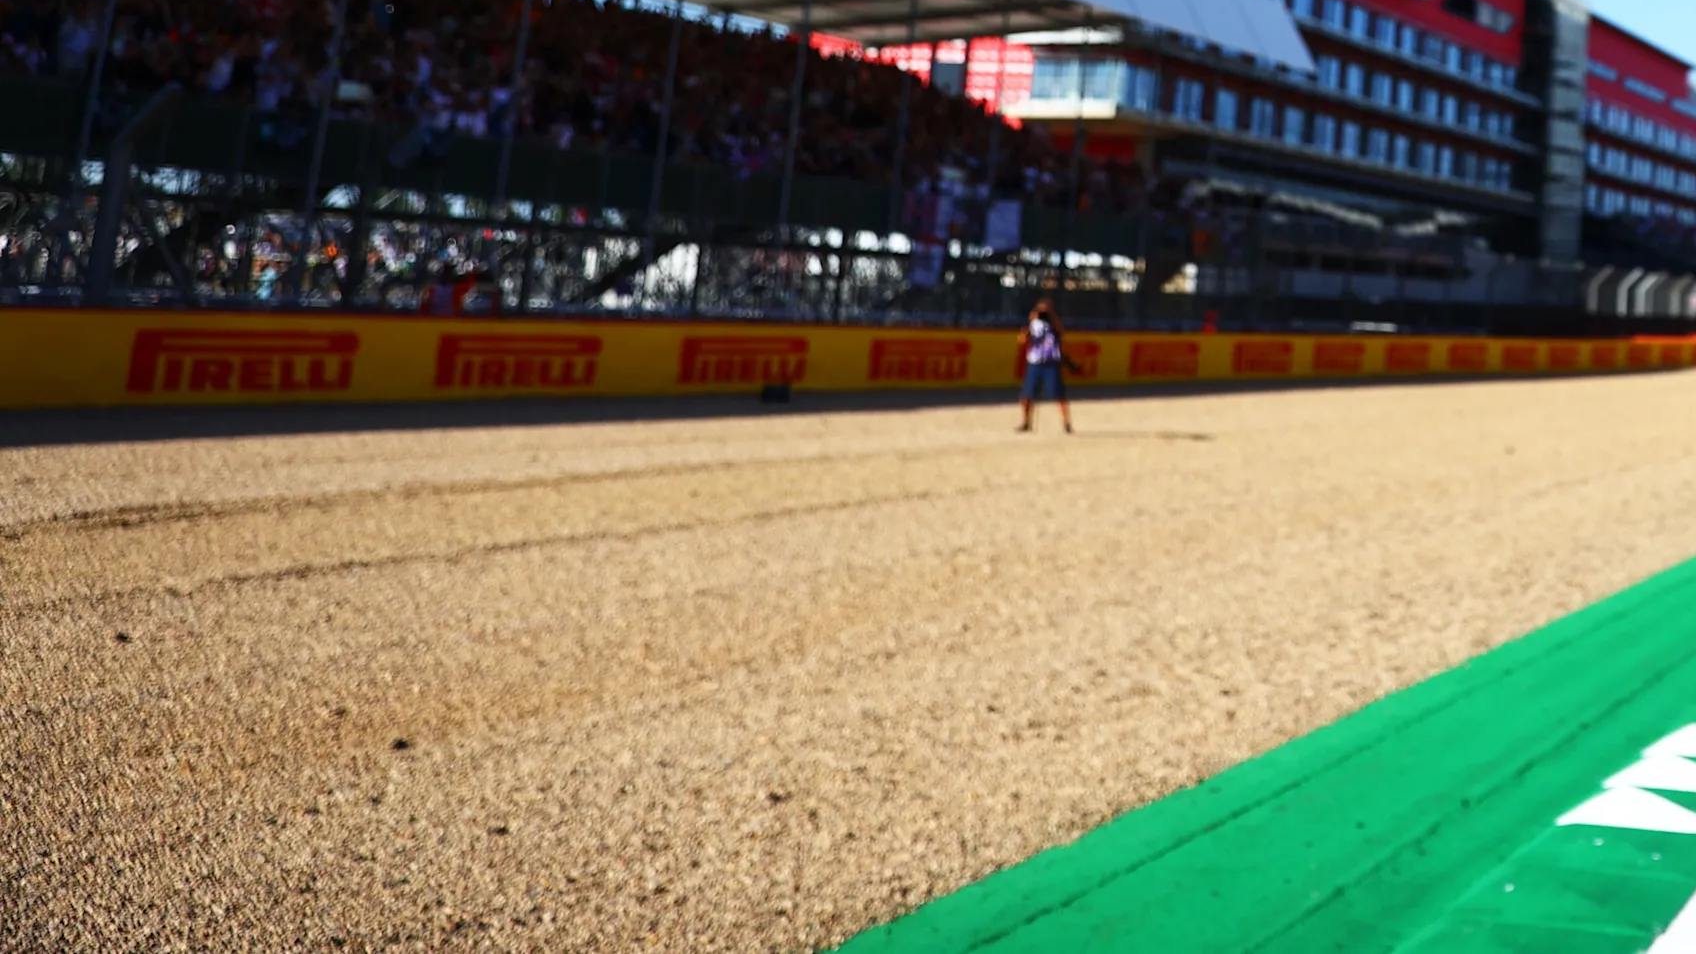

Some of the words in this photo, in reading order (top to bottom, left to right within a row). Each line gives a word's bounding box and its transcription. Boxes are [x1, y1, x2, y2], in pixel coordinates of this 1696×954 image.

[125, 329, 360, 394] PIRELLI
[433, 334, 602, 388] PIRELLI
[677, 336, 810, 385] PIRELLI
